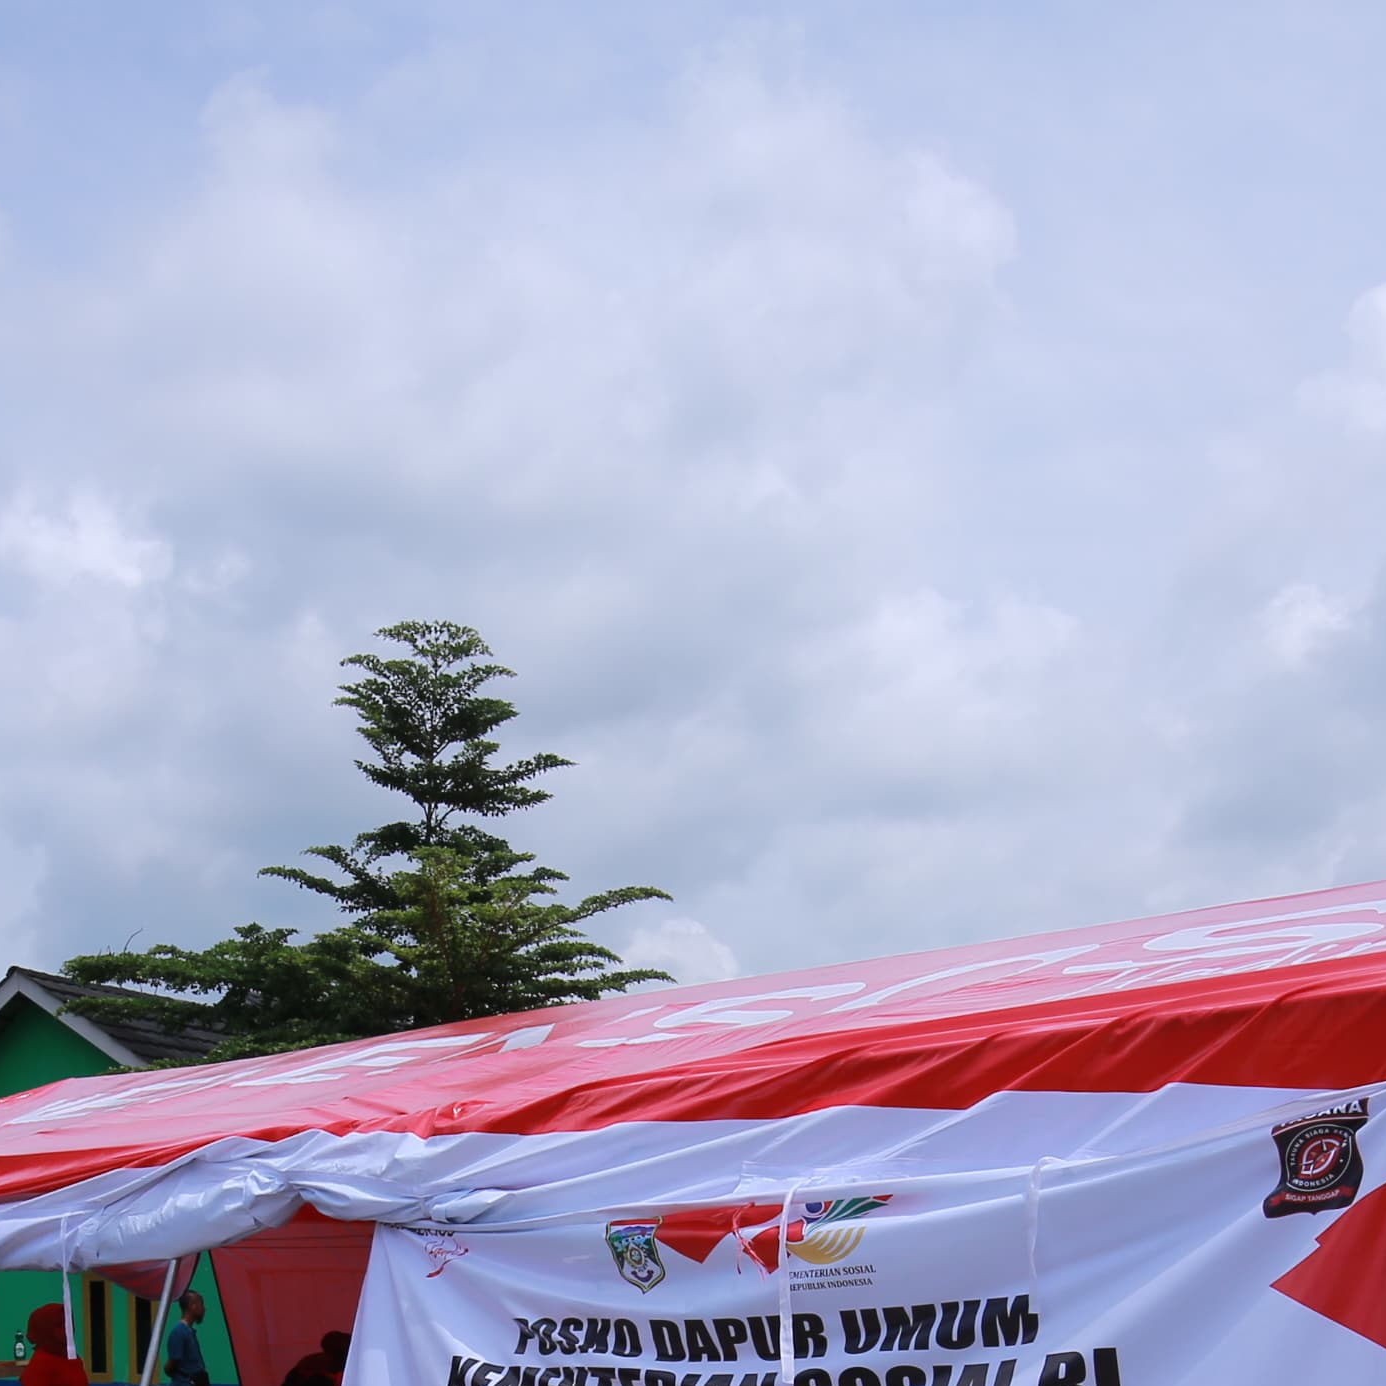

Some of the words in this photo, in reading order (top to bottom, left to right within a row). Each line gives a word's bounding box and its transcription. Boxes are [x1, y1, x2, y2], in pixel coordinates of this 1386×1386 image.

[789, 1267, 841, 1280] EMENTERIAN
[843, 1264, 877, 1275] SOSIAL
[827, 1277, 873, 1288] INDONESIA
[514, 1317, 642, 1357] POSKO
[649, 1313, 827, 1362] DAPUR
[840, 1294, 1038, 1354] UMUM
